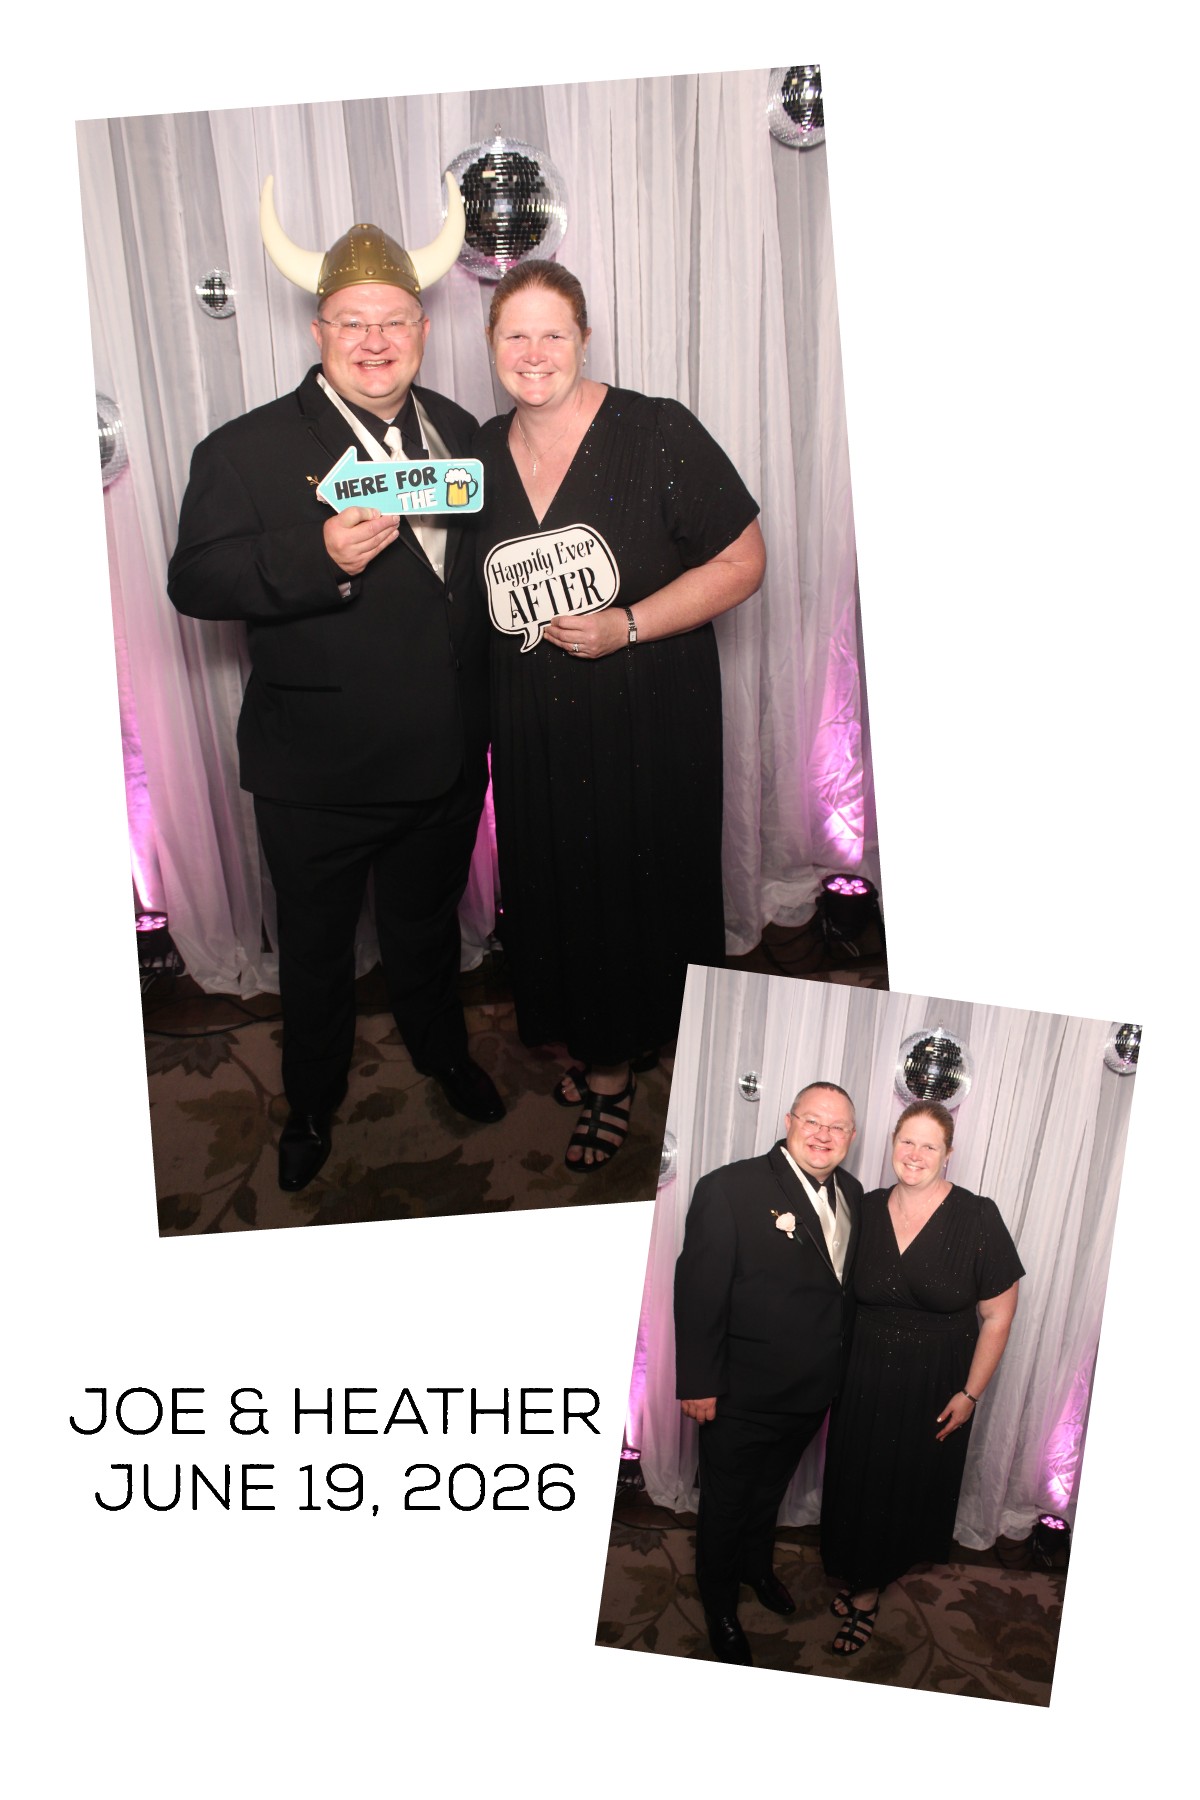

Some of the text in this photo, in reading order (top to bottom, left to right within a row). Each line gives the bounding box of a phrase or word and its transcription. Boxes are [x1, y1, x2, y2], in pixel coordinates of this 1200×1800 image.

[334, 466, 438, 500] HERE FOR
[396, 488, 438, 511] THE
[491, 539, 595, 587] Happily Ever
[508, 567, 604, 628] AFTER
